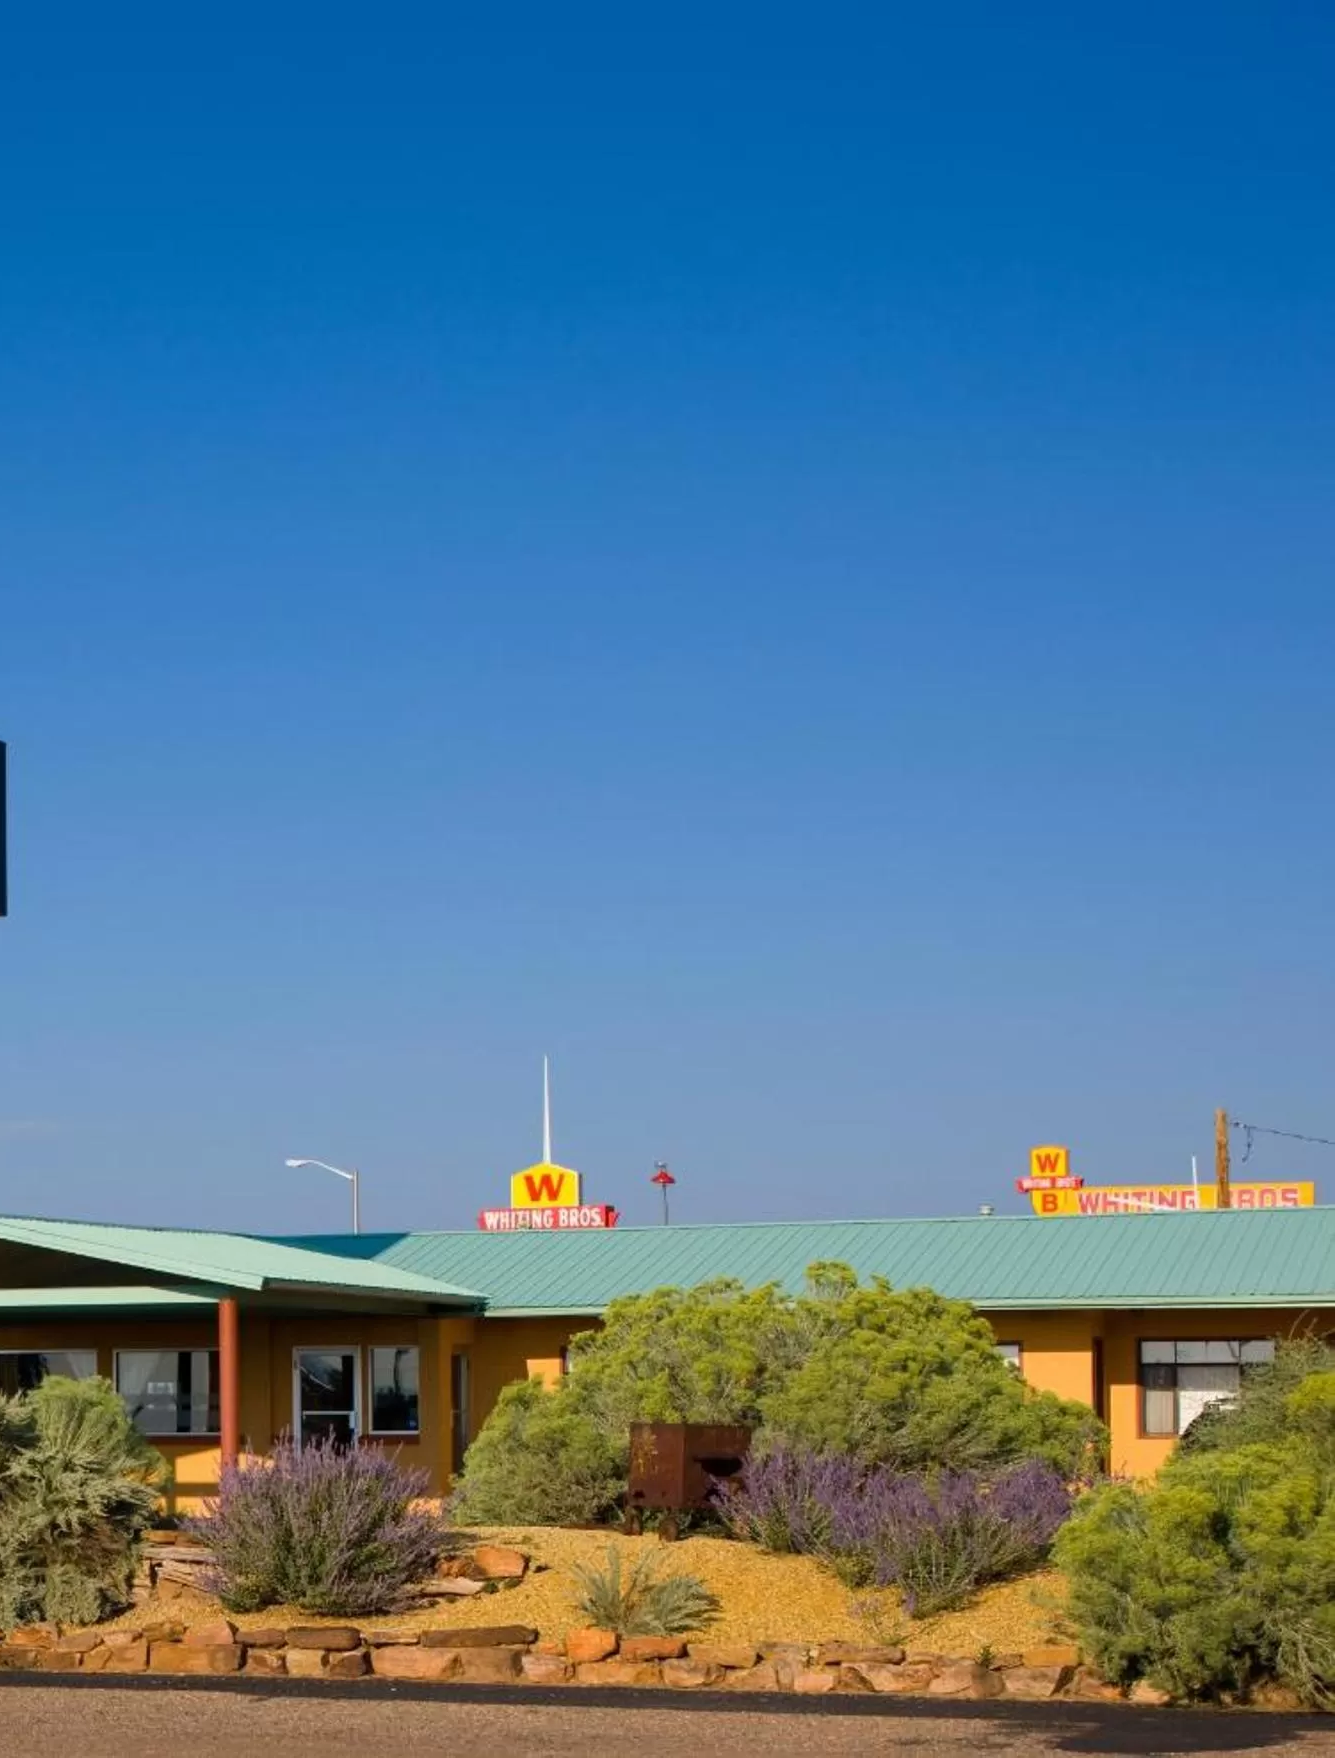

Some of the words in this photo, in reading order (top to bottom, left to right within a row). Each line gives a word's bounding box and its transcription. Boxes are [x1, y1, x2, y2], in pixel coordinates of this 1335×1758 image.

[1036, 1152, 1060, 1173] W
[523, 1173, 565, 1202] W
[1217, 1186, 1298, 1209] ROS
[1041, 1193, 1059, 1213] B
[484, 1209, 554, 1230] WHITING
[558, 1207, 605, 1228] BROS.
